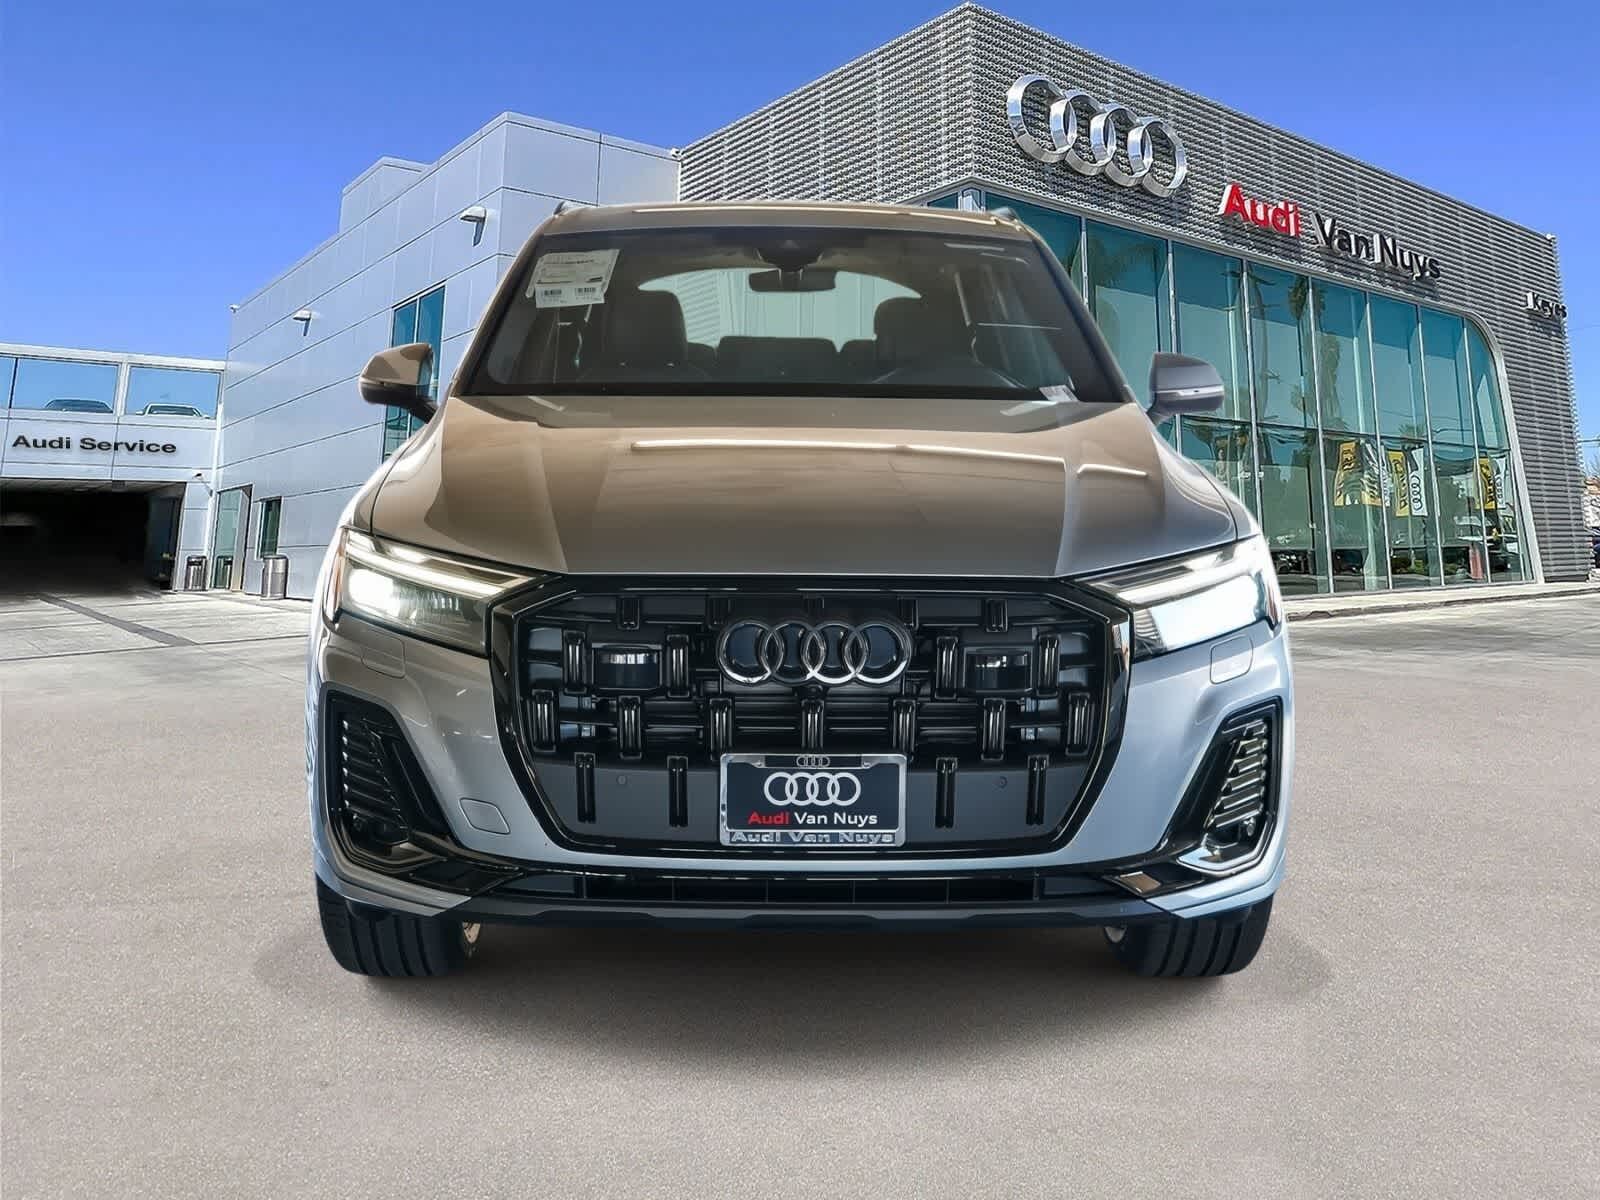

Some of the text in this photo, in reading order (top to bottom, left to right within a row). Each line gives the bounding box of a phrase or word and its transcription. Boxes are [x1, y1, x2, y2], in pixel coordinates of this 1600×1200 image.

[1218, 183, 1441, 280] Audi Van Nuys
[1526, 292, 1567, 318] Keyes
[12, 435, 177, 453] Audi Service
[748, 812, 878, 827] Audi Van Nuys
[731, 832, 894, 843] Audi Van Nuys
